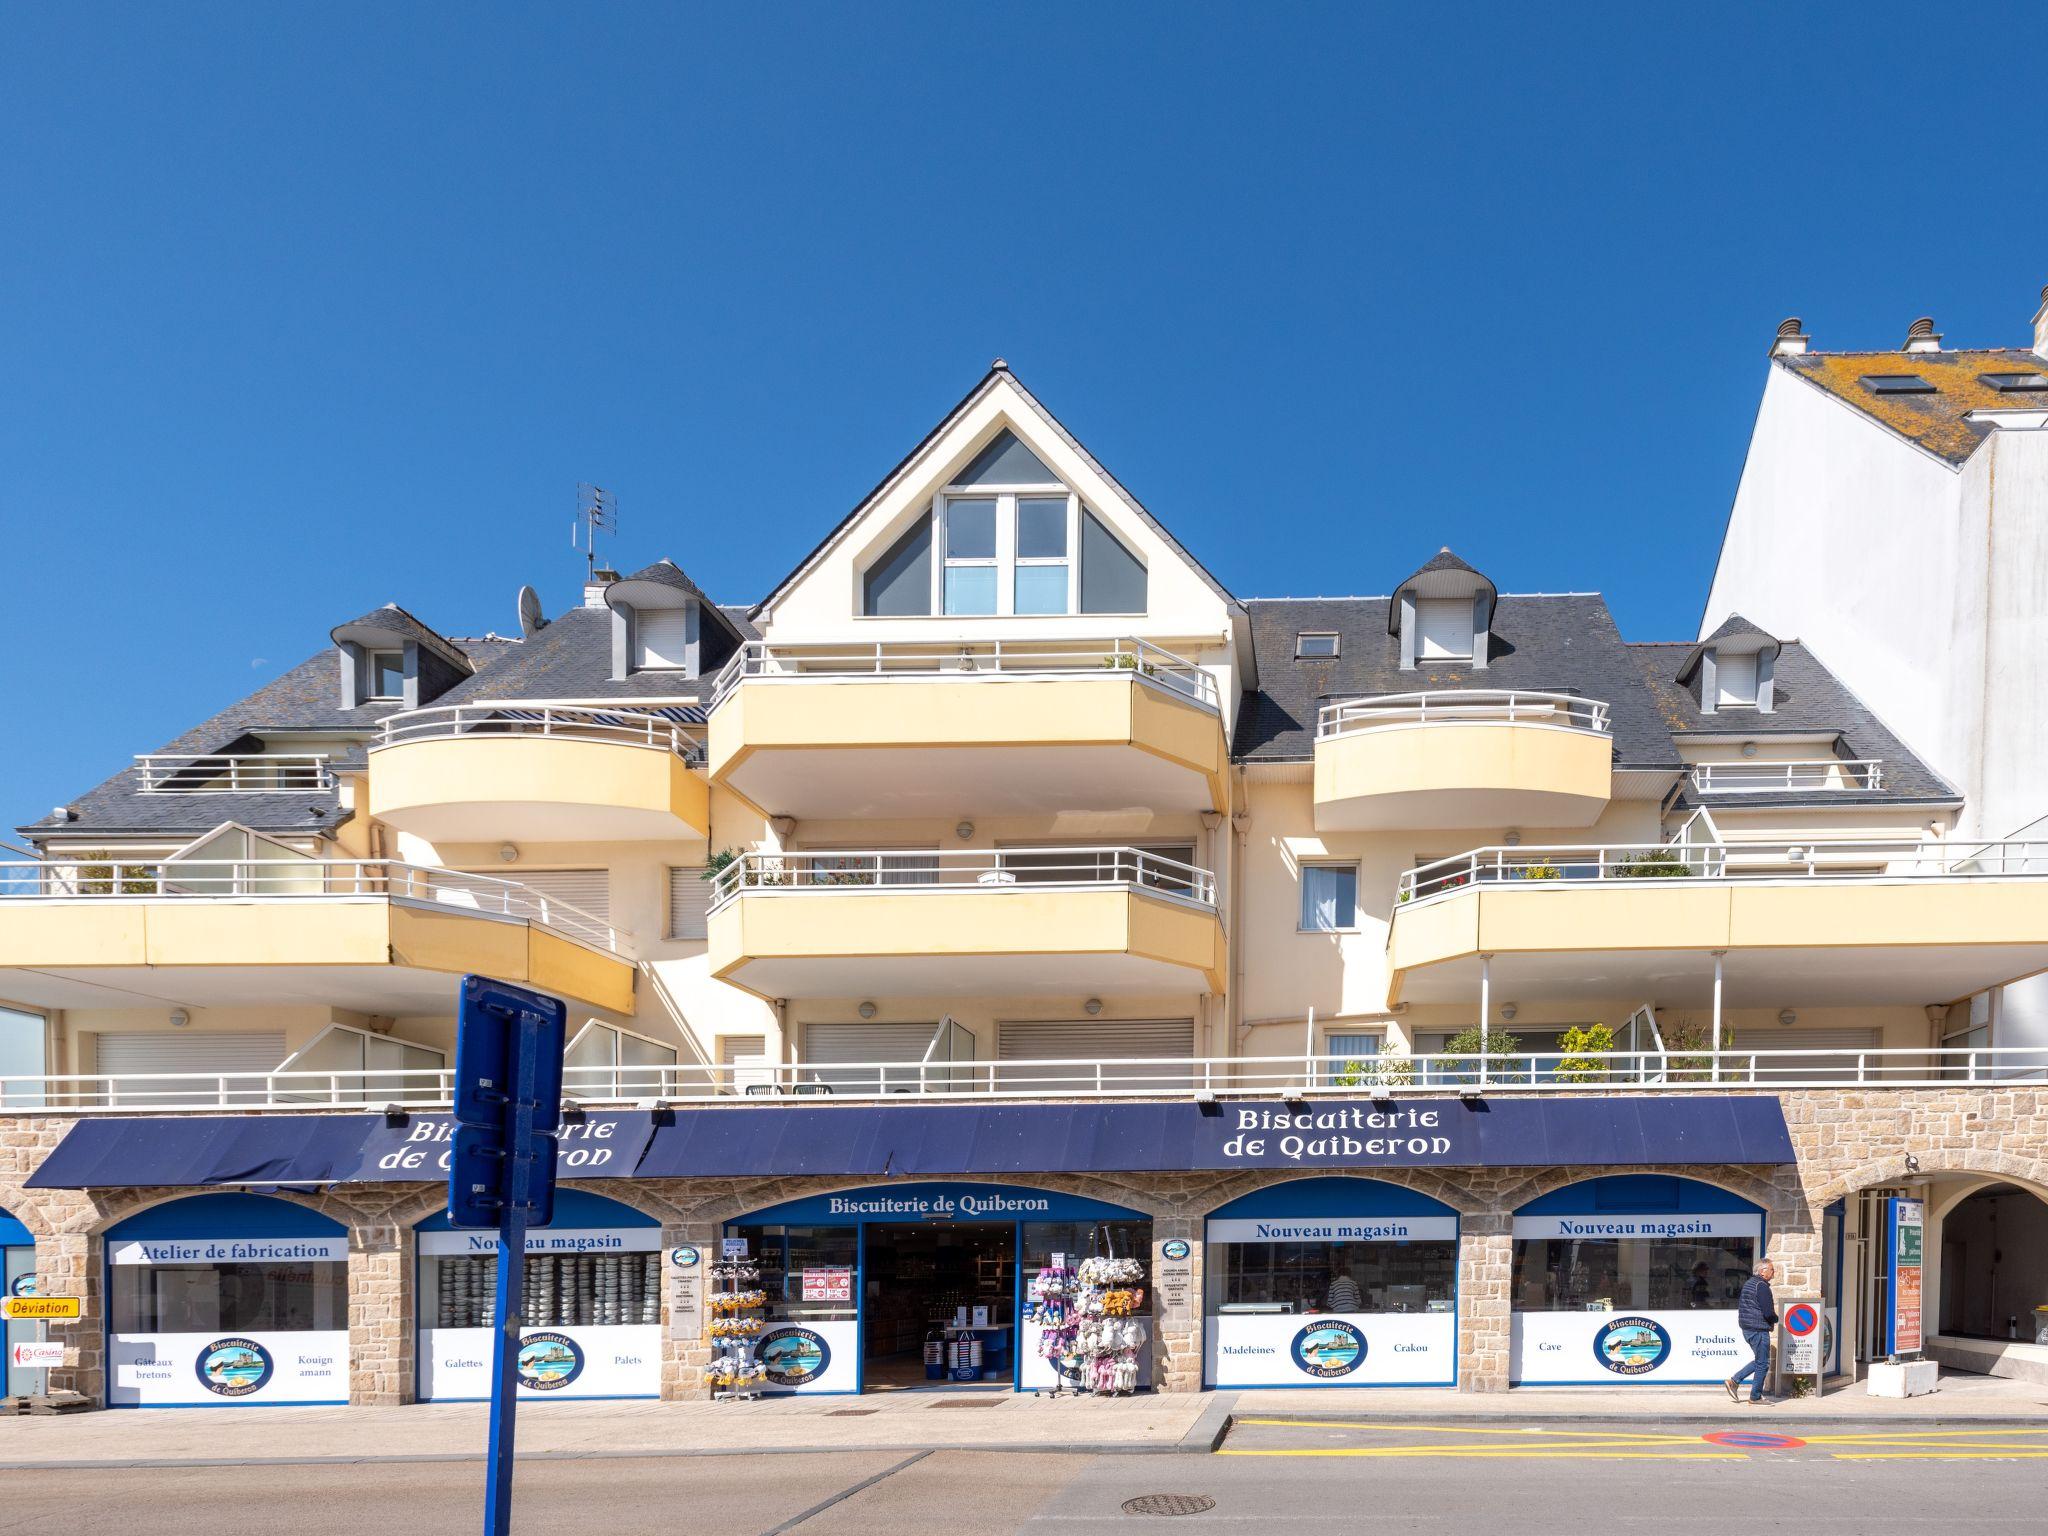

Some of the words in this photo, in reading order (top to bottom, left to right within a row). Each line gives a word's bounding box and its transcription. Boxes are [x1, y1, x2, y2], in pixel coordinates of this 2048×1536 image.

[1236, 1107, 1440, 1130] Biscuiterie
[1223, 1134, 1265, 1156] de
[1280, 1135, 1451, 1160] Quiberon
[378, 1146, 428, 1169] de
[829, 1197, 929, 1214] Biscuiterie
[933, 1196, 955, 1211] de
[960, 1195, 1049, 1215] Quiberon
[1256, 1224, 1332, 1238] Nouveau
[1337, 1223, 1408, 1240] magasin
[1559, 1220, 1635, 1235] Nouveau
[1640, 1220, 1712, 1237] magasin
[551, 1234, 622, 1251] magasin
[139, 1245, 200, 1259] Atelier
[205, 1243, 226, 1258] de
[231, 1243, 330, 1258] fabrication
[12, 1302, 69, 1314] Déviation
[1305, 1321, 1354, 1335] Biscuiterie
[1608, 1318, 1657, 1332] Biscuiterie
[521, 1333, 570, 1346] Biscuiterie
[769, 1329, 817, 1341] Biscuiterie
[1695, 1335, 1736, 1344] Produits
[209, 1339, 259, 1353] Biscuiterie
[1222, 1345, 1276, 1355] Madeleines
[1393, 1343, 1428, 1352] Crakou
[1539, 1342, 1562, 1351] Cave
[1691, 1346, 1739, 1358] régionaux
[33, 1348, 63, 1357] Casino
[134, 1357, 173, 1367] Gâteaux
[298, 1355, 333, 1366] Kouign
[445, 1359, 483, 1368] Galettes
[614, 1356, 643, 1365] Palets
[299, 1368, 332, 1376] amann
[1306, 1364, 1316, 1375] de
[1317, 1365, 1351, 1377] Quiberon
[1609, 1362, 1619, 1371] de
[1620, 1362, 1654, 1374] Quiberon
[136, 1370, 172, 1379] bretons
[780, 1373, 814, 1384] Quiberon
[211, 1384, 221, 1393] de
[222, 1383, 257, 1396] Quiberon
[523, 1378, 533, 1387] de
[533, 1378, 568, 1390] Quiberon
